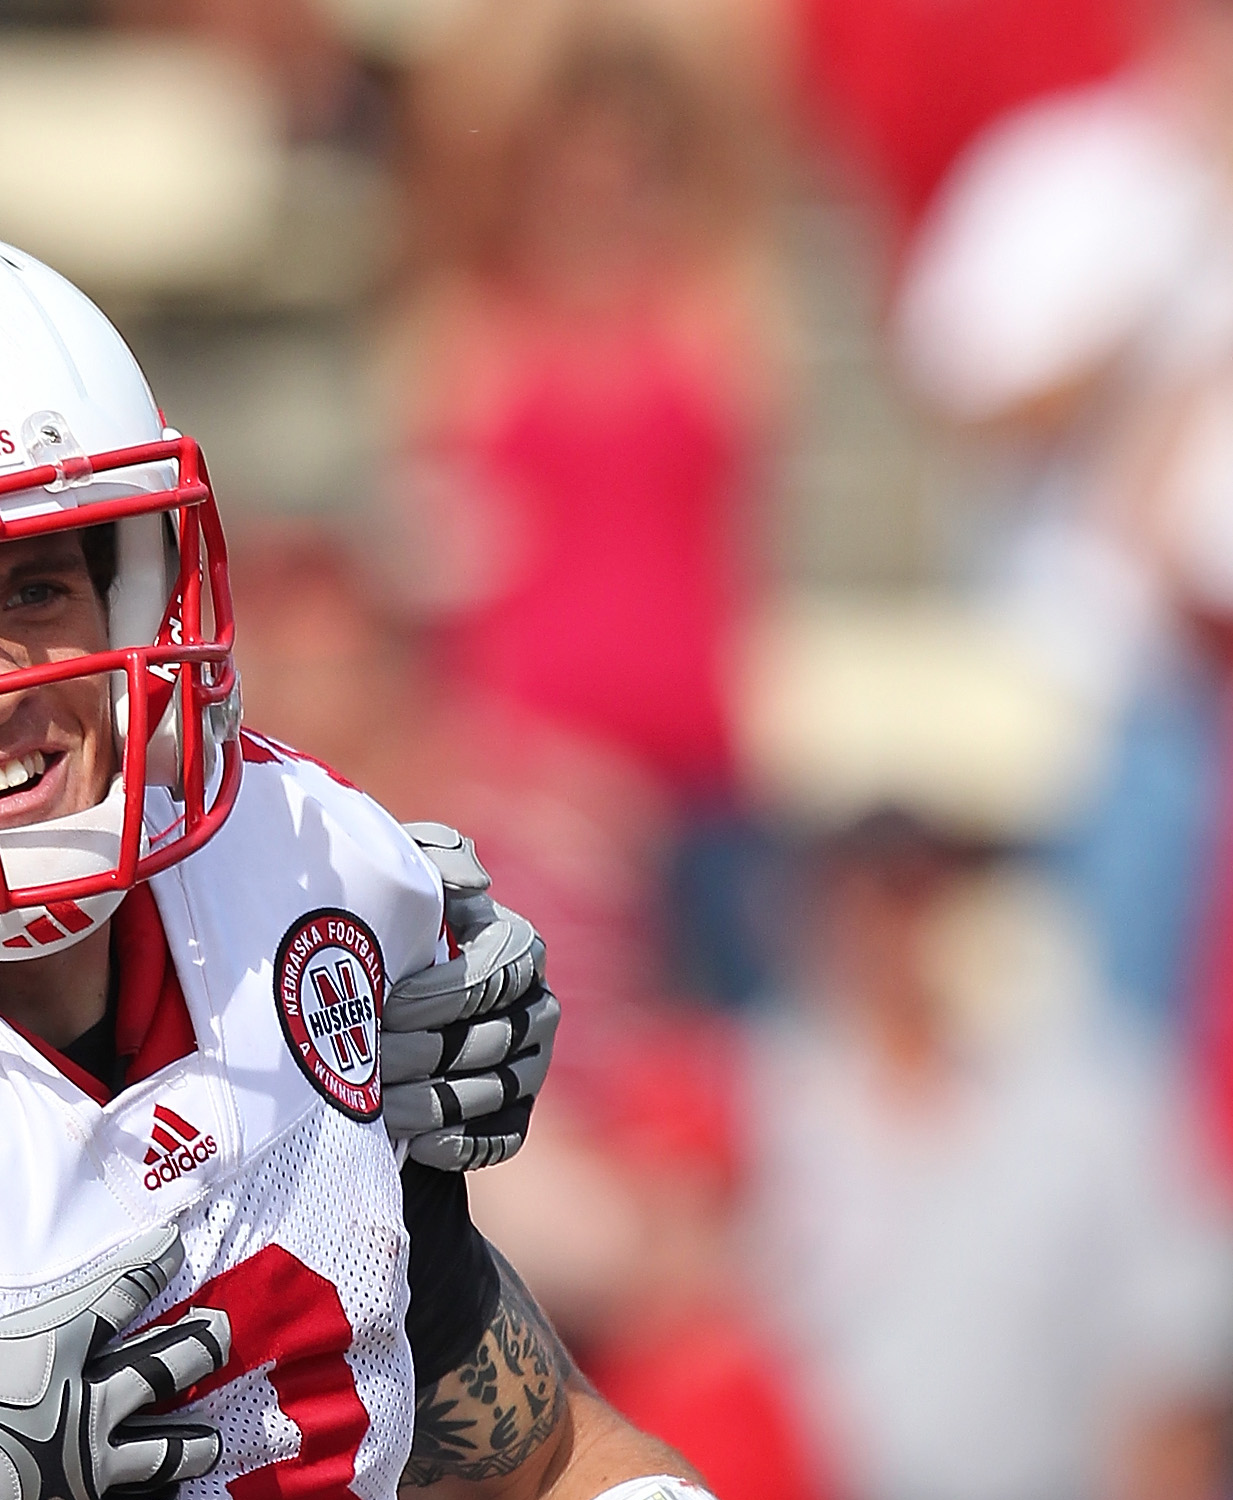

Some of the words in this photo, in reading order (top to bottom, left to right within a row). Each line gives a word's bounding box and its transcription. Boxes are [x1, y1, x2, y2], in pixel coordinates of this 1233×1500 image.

[285, 925, 323, 1016] NEBRASKA
[327, 921, 381, 991] FOOTBALL
[308, 995, 372, 1038] HUSKERS
[299, 1042, 311, 1057] A
[314, 1060, 367, 1110] WINNING
[144, 1135, 217, 1191] adidas
